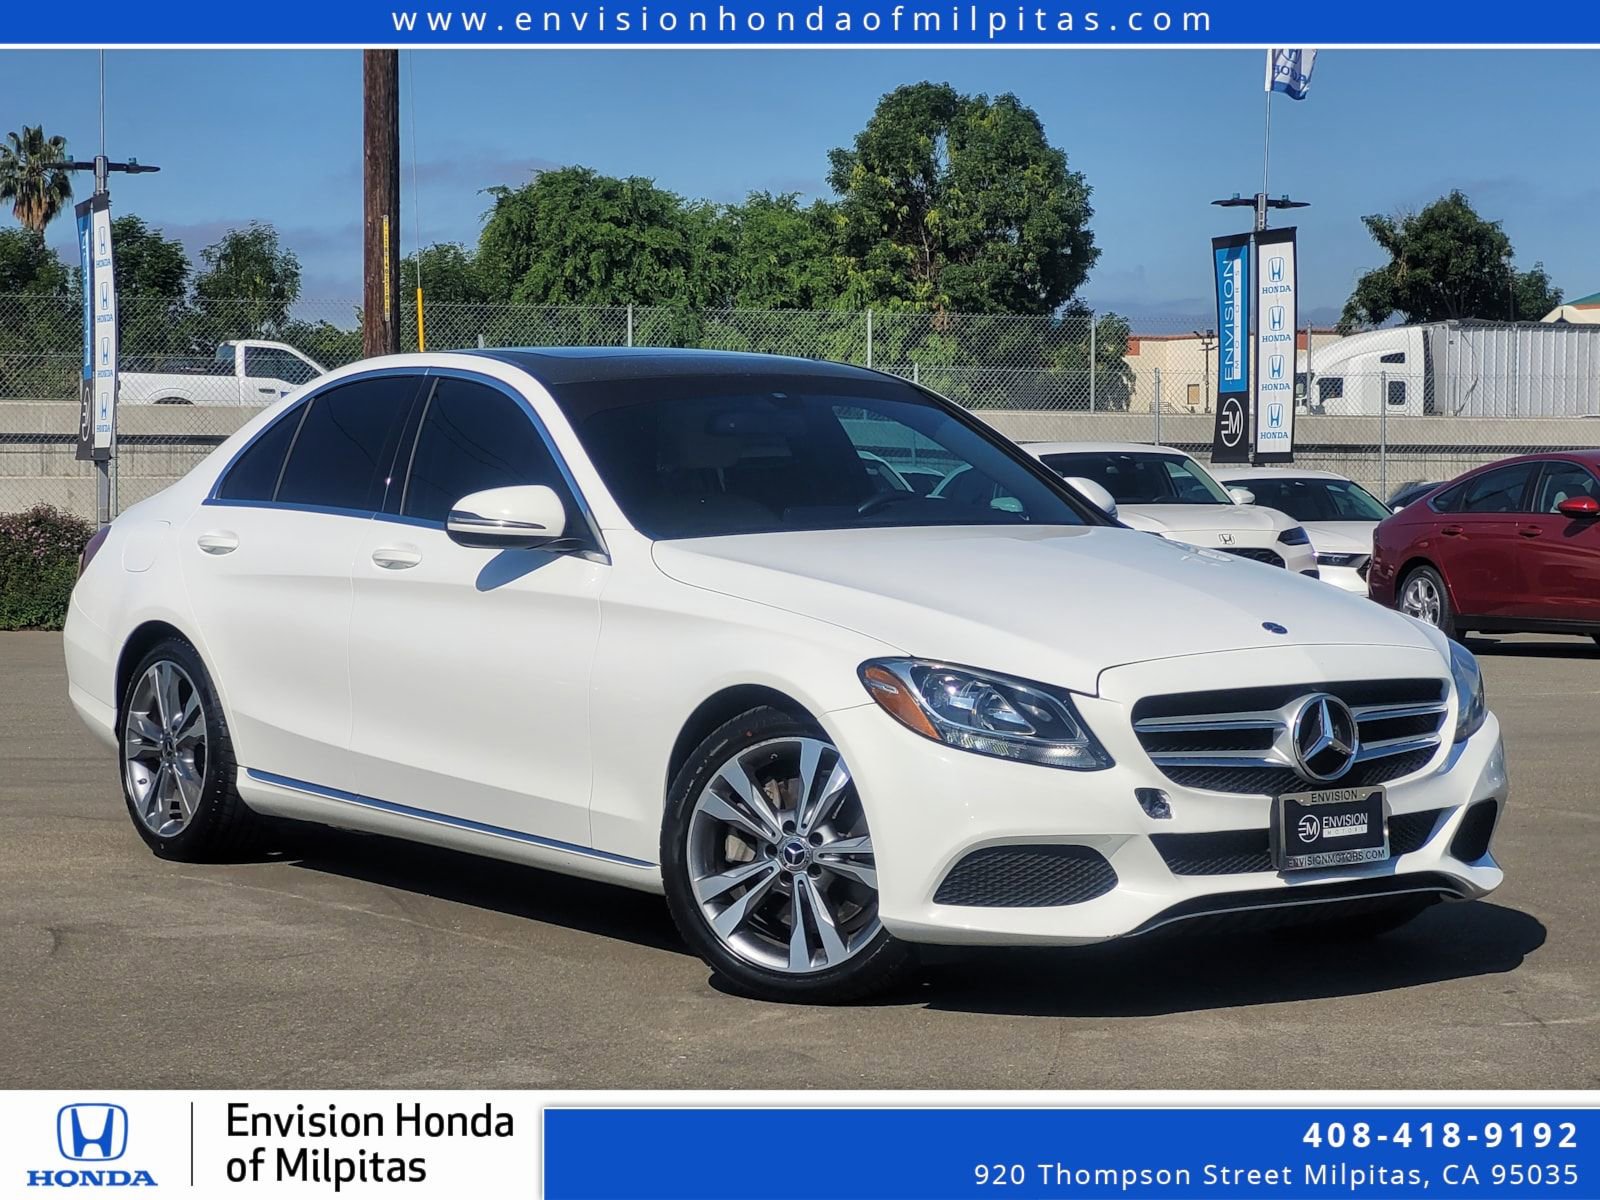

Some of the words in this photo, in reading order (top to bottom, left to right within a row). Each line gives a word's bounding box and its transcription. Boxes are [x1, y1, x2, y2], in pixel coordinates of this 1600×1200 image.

[1262, 285, 1292, 294] HONDA
[1222, 260, 1234, 380] ENVISION
[1262, 334, 1292, 343] HONDA
[1261, 383, 1291, 391] HONDA
[1260, 431, 1289, 440] HONDA
[1311, 789, 1358, 803] ENVISION
[1322, 812, 1368, 828] ENVISION
[1288, 849, 1386, 867] ENVISIONMOTORS.COM
